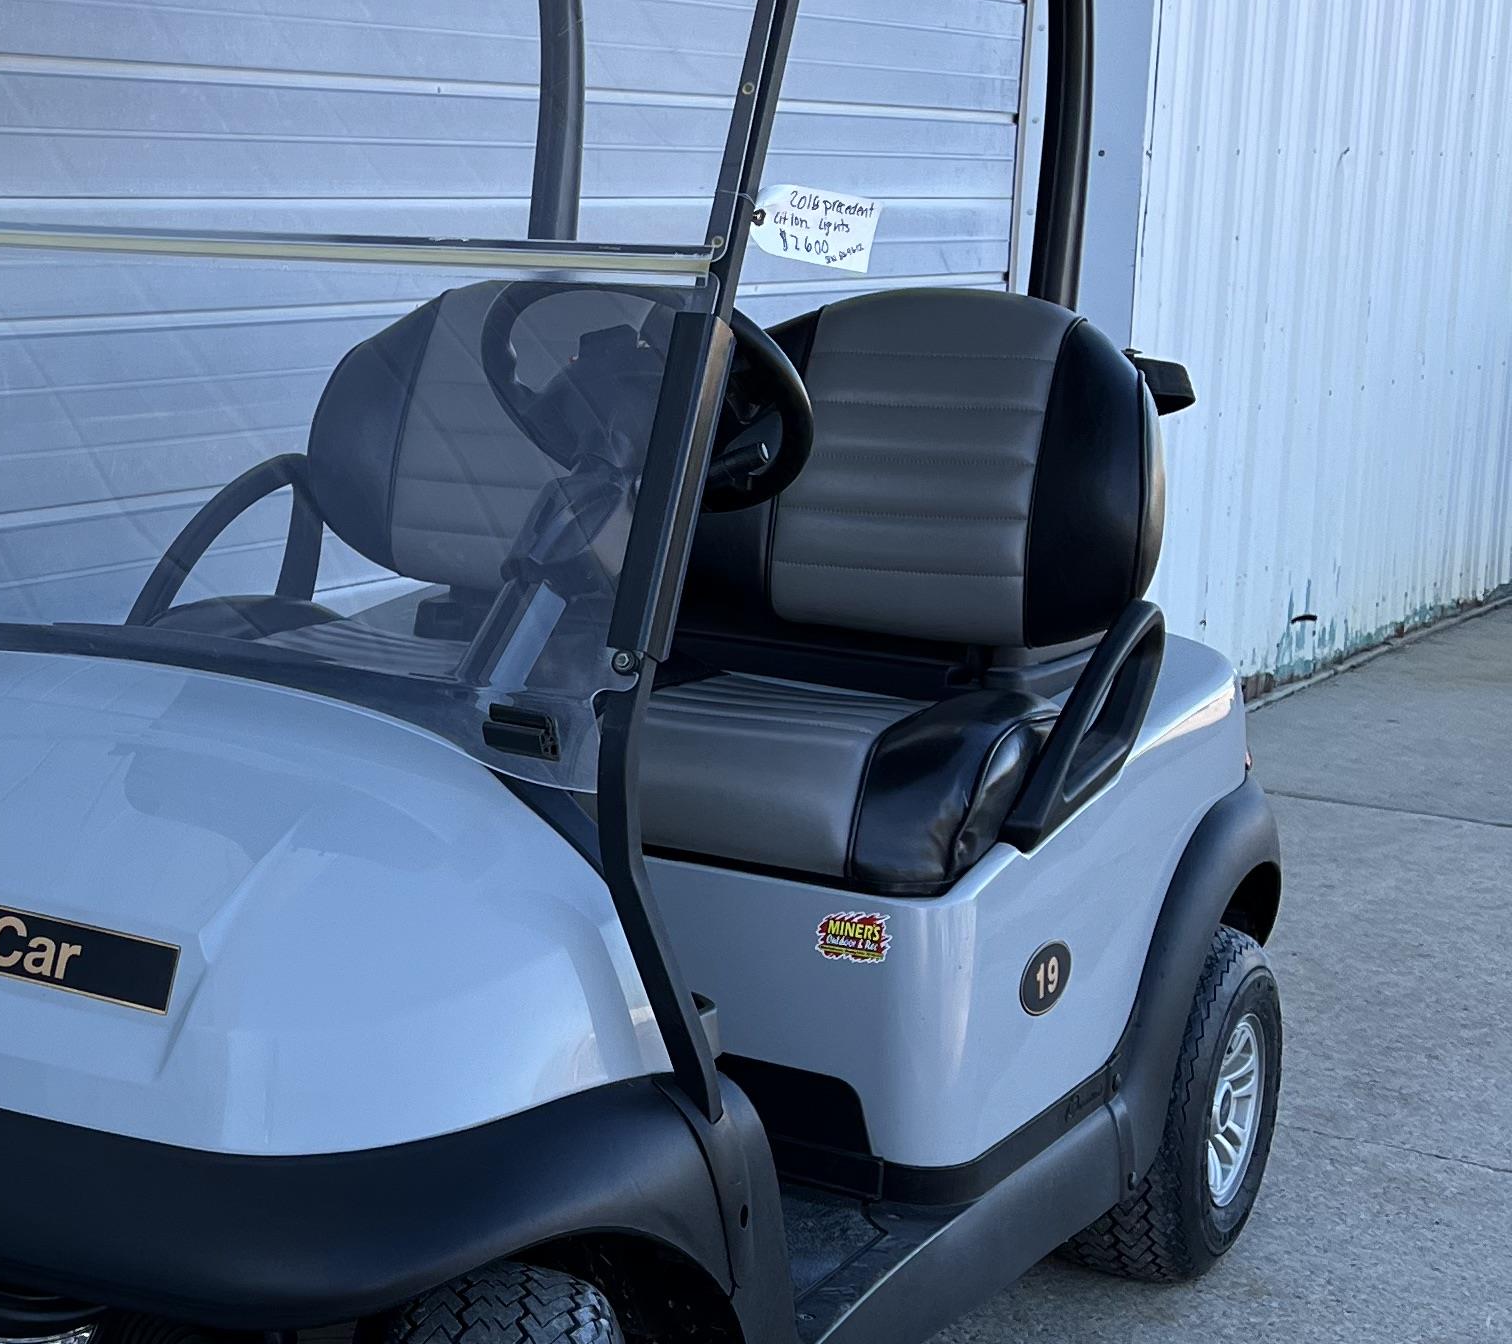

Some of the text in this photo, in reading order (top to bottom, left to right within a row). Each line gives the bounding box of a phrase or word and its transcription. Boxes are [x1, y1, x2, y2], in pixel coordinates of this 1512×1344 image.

[779, 227, 830, 256] $2600
[825, 933, 857, 948] Outdoor
[864, 939, 880, 951] Rec
[827, 919, 882, 942] MINER'S
[1036, 955, 1059, 1000] 19
